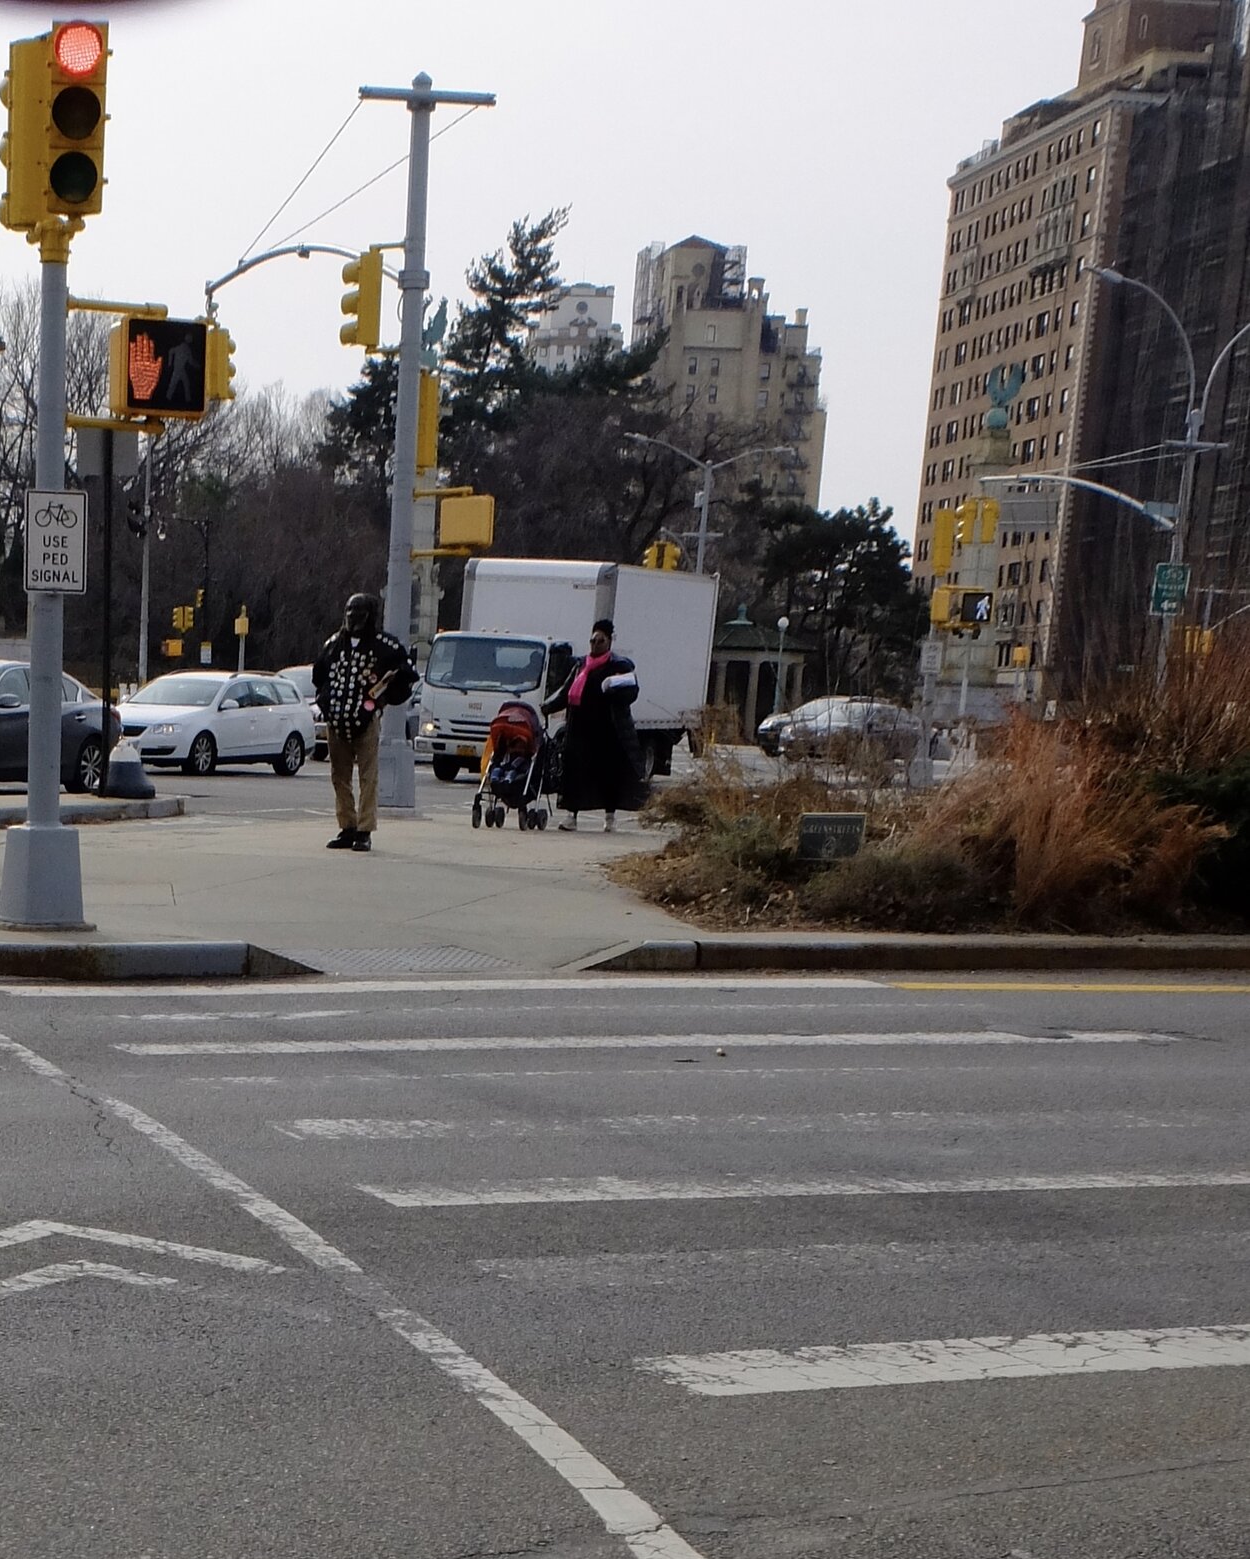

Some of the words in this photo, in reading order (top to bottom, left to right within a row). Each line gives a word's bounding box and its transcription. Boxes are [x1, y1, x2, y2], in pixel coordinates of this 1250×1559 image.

[43, 535, 69, 548] USE
[42, 552, 69, 565] PED
[31, 569, 79, 583] SIGNAL
